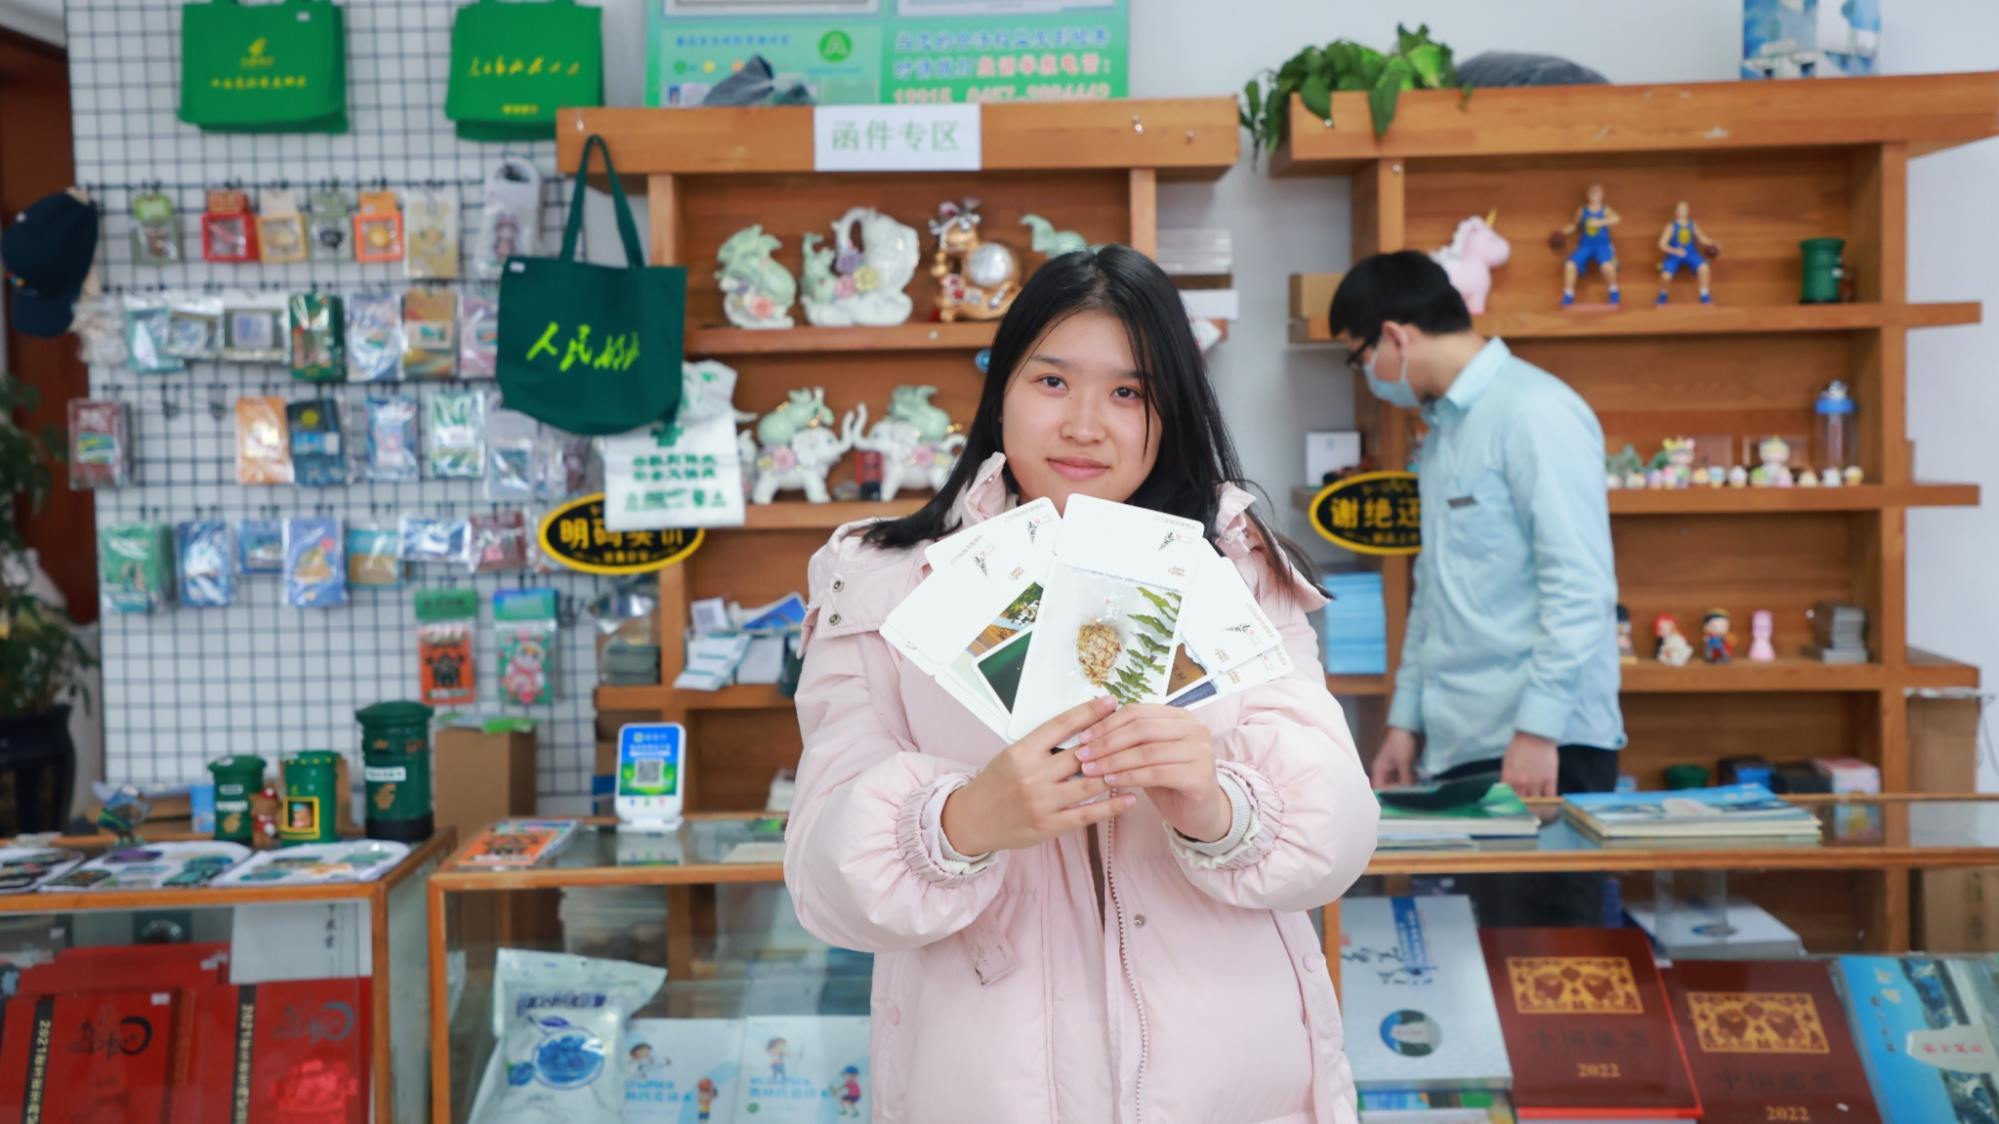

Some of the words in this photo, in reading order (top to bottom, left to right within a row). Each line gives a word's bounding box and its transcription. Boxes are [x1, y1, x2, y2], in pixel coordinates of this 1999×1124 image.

[831, 120, 960, 151] 函件专区
[1577, 1063, 1621, 1078] 2022
[1766, 1105, 1811, 1121] 2022
